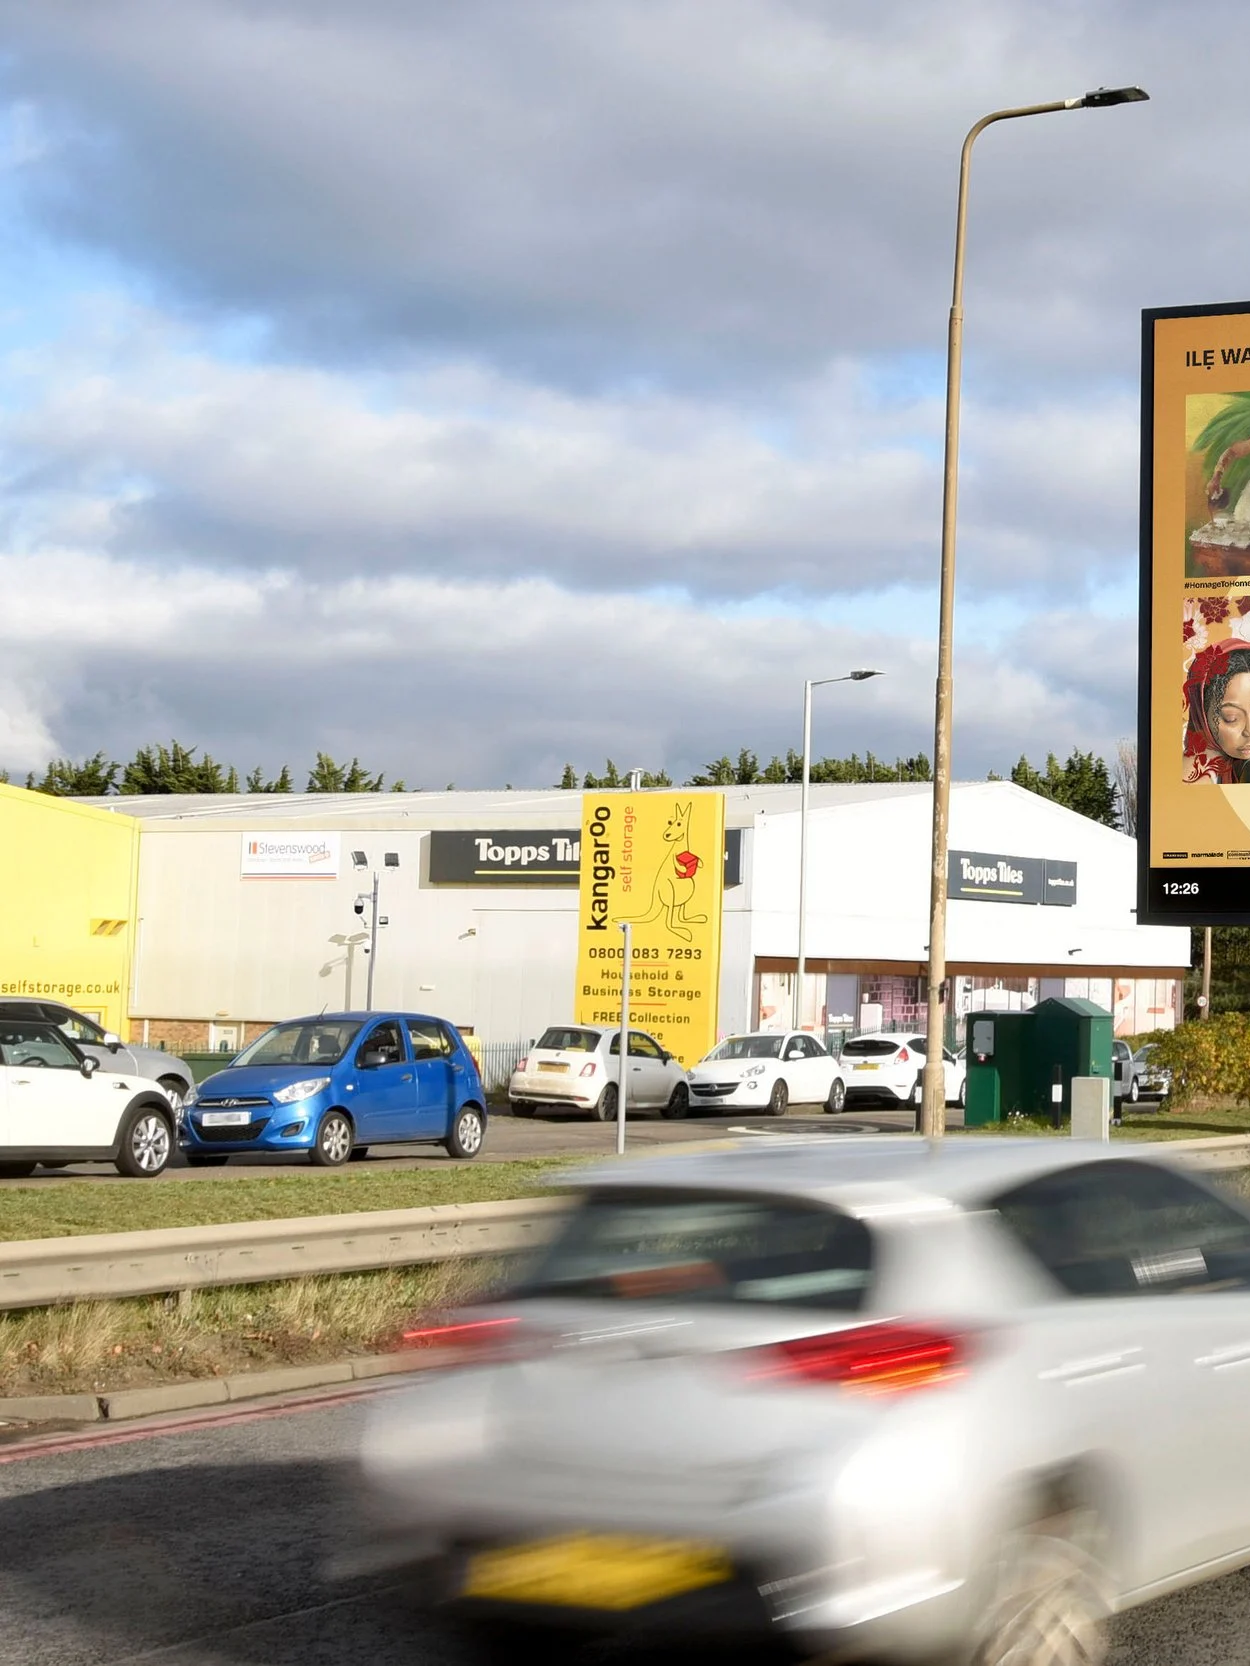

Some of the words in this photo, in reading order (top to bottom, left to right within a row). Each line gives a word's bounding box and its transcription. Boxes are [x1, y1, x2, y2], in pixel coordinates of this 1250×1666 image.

[621, 805, 637, 864] storage
[259, 842, 326, 854] Stevenswood
[475, 838, 550, 865] Topps
[552, 838, 580, 861] Til
[960, 858, 997, 885] Topps
[997, 861, 1024, 884] Tiles
[621, 867, 632, 892] self
[1163, 883, 1199, 894] 12:26
[589, 948, 625, 959] 0800
[632, 948, 659, 959] 083
[667, 948, 702, 960] 7293
[675, 970, 684, 981] &
[648, 986, 701, 1001] Storage
[593, 1011, 624, 1022] FREE
[629, 1012, 690, 1024] Collection
